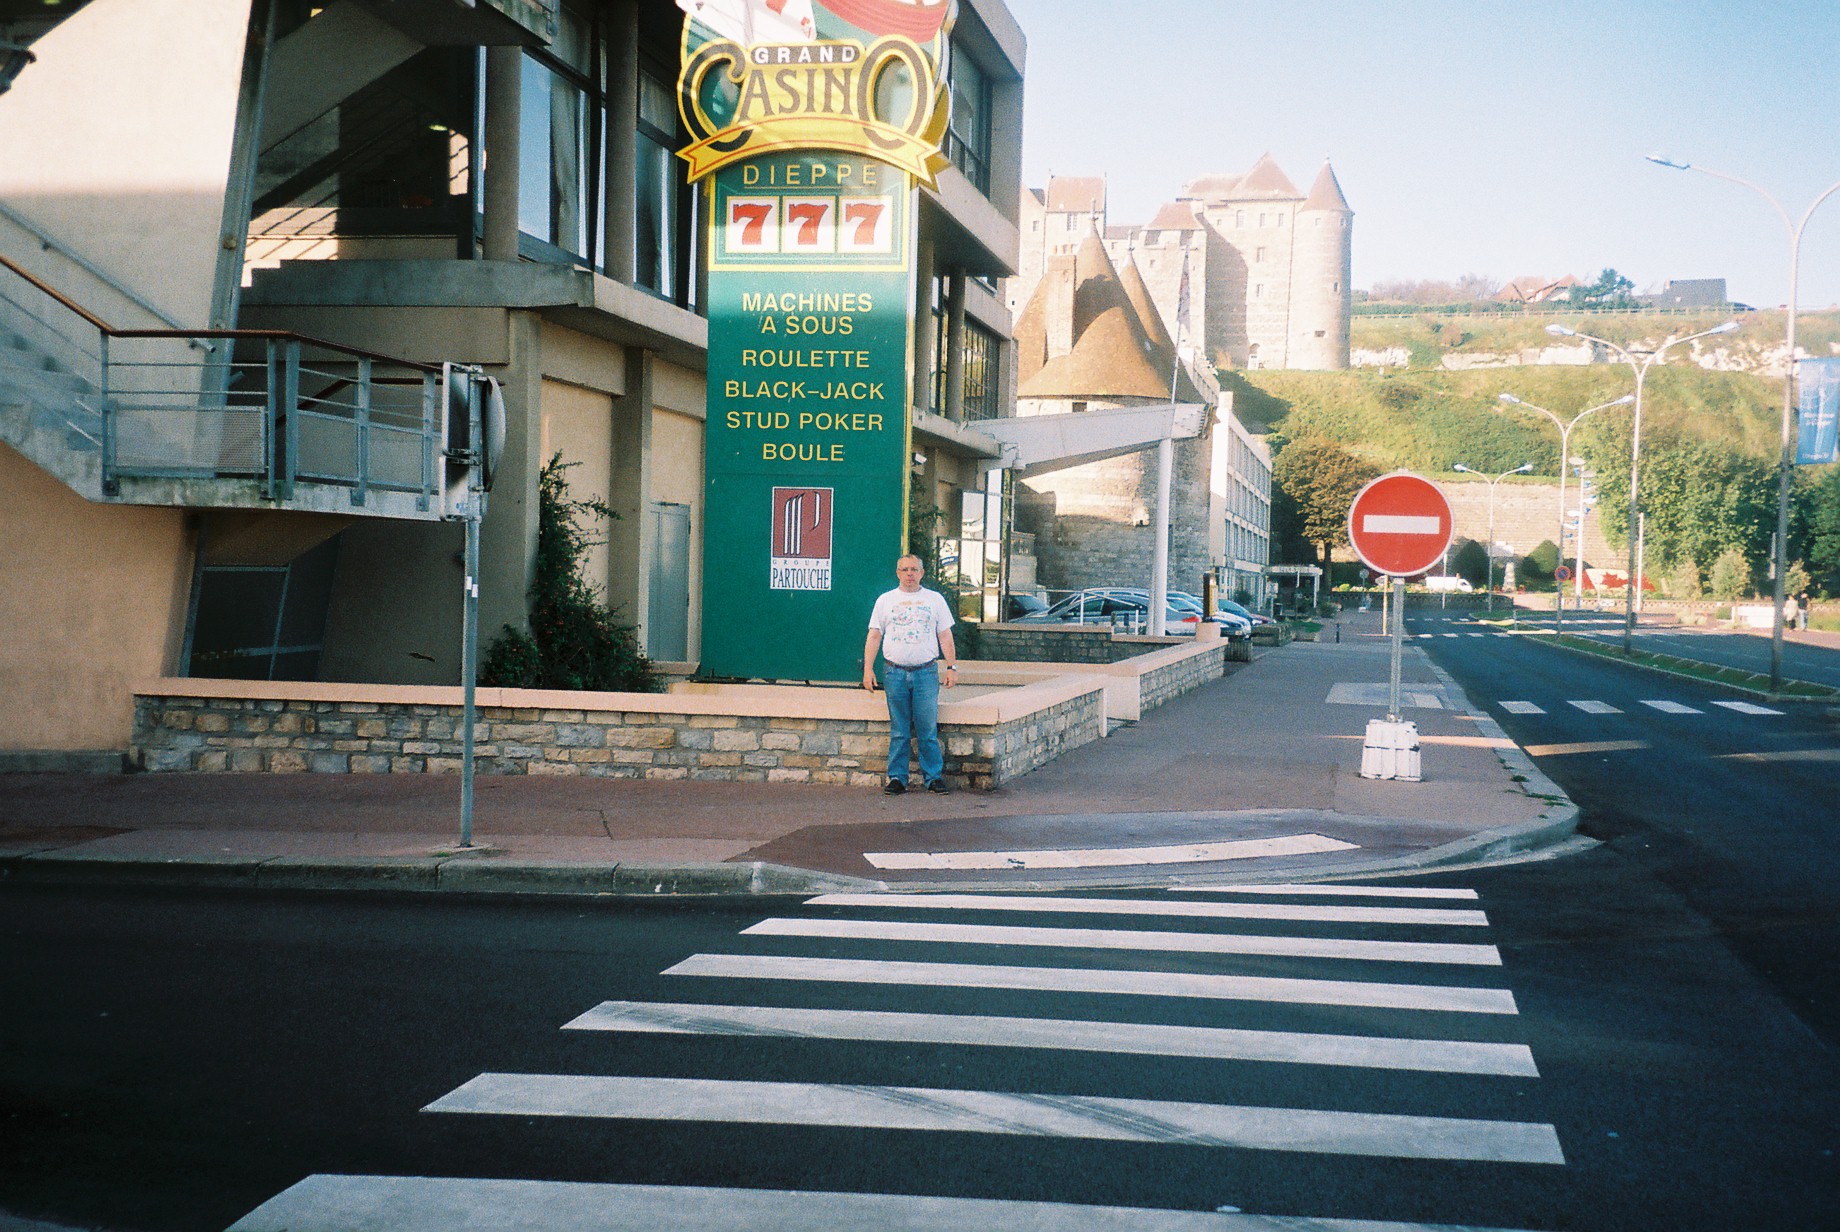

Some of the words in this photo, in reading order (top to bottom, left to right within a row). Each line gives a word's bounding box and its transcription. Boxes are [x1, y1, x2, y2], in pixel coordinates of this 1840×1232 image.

[754, 46, 856, 64] GRAND
[681, 39, 929, 151] CASINO
[743, 164, 878, 185] DIEPPE
[732, 203, 773, 245] 7
[788, 203, 830, 245] 7
[845, 203, 886, 245] 7
[742, 292, 873, 313] MACHINES
[761, 316, 776, 334] A
[785, 316, 853, 335] SOUS
[742, 350, 870, 368] ROULETTE
[725, 380, 885, 400] BLACK-JACK
[726, 411, 790, 429] STUD
[799, 413, 883, 431] POKER
[762, 443, 844, 461] BOULE
[772, 559, 829, 567] GROUPE
[772, 567, 830, 589] PARTOUCHE
